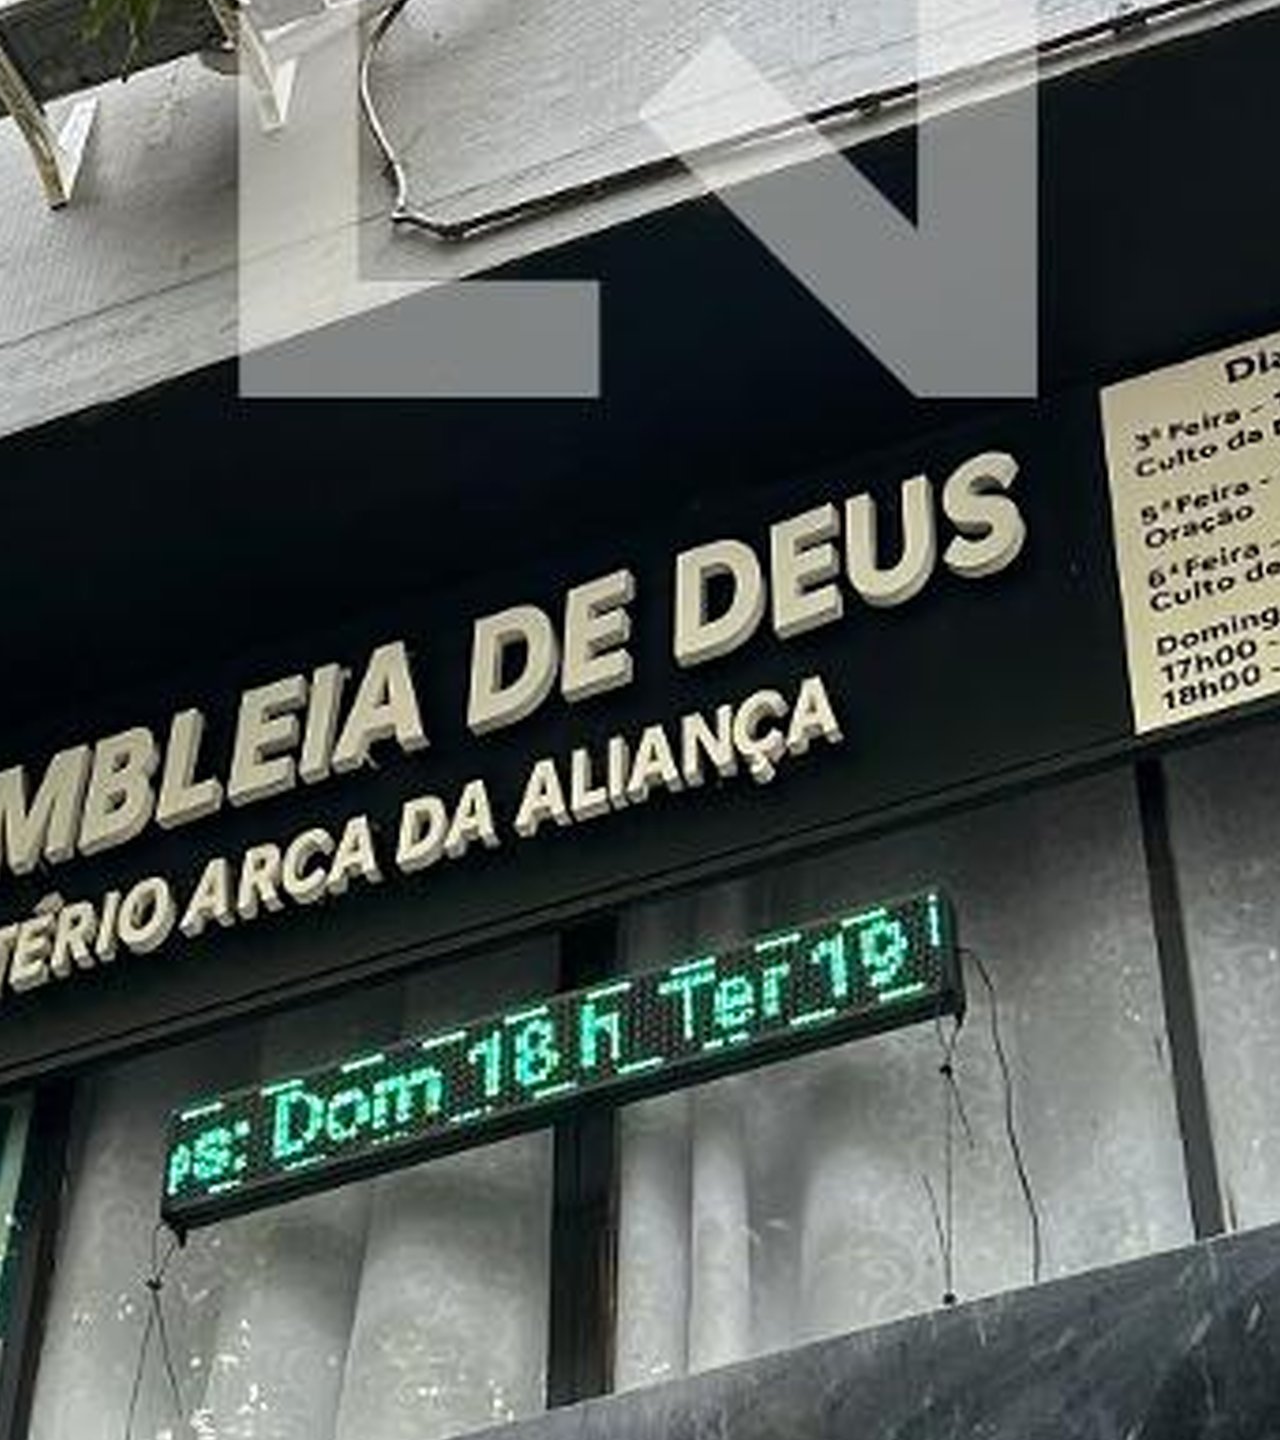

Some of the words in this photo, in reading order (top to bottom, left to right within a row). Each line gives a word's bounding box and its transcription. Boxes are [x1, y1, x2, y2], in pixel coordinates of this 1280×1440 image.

[1168, 409, 1242, 440] Feira
[1135, 442, 1219, 478] Culto
[1226, 430, 1264, 451] da
[1175, 481, 1251, 514] Feira
[1144, 504, 1254, 549] Oração
[1184, 542, 1261, 578] Feira
[465, 567, 636, 736] DE
[672, 450, 1027, 668] DEUS
[1149, 575, 1236, 613] Culto
[1160, 639, 1258, 684] 17h00
[1161, 665, 1261, 710] 18h00
[178, 814, 384, 940] ARCA
[395, 778, 501, 876] DA
[513, 674, 843, 838] ALIANÇA
[272, 1066, 444, 1159] Dom
[468, 1009, 560, 1099] 18
[578, 1003, 622, 1071] h
[657, 964, 790, 1041] Ter
[811, 919, 908, 998] 19
